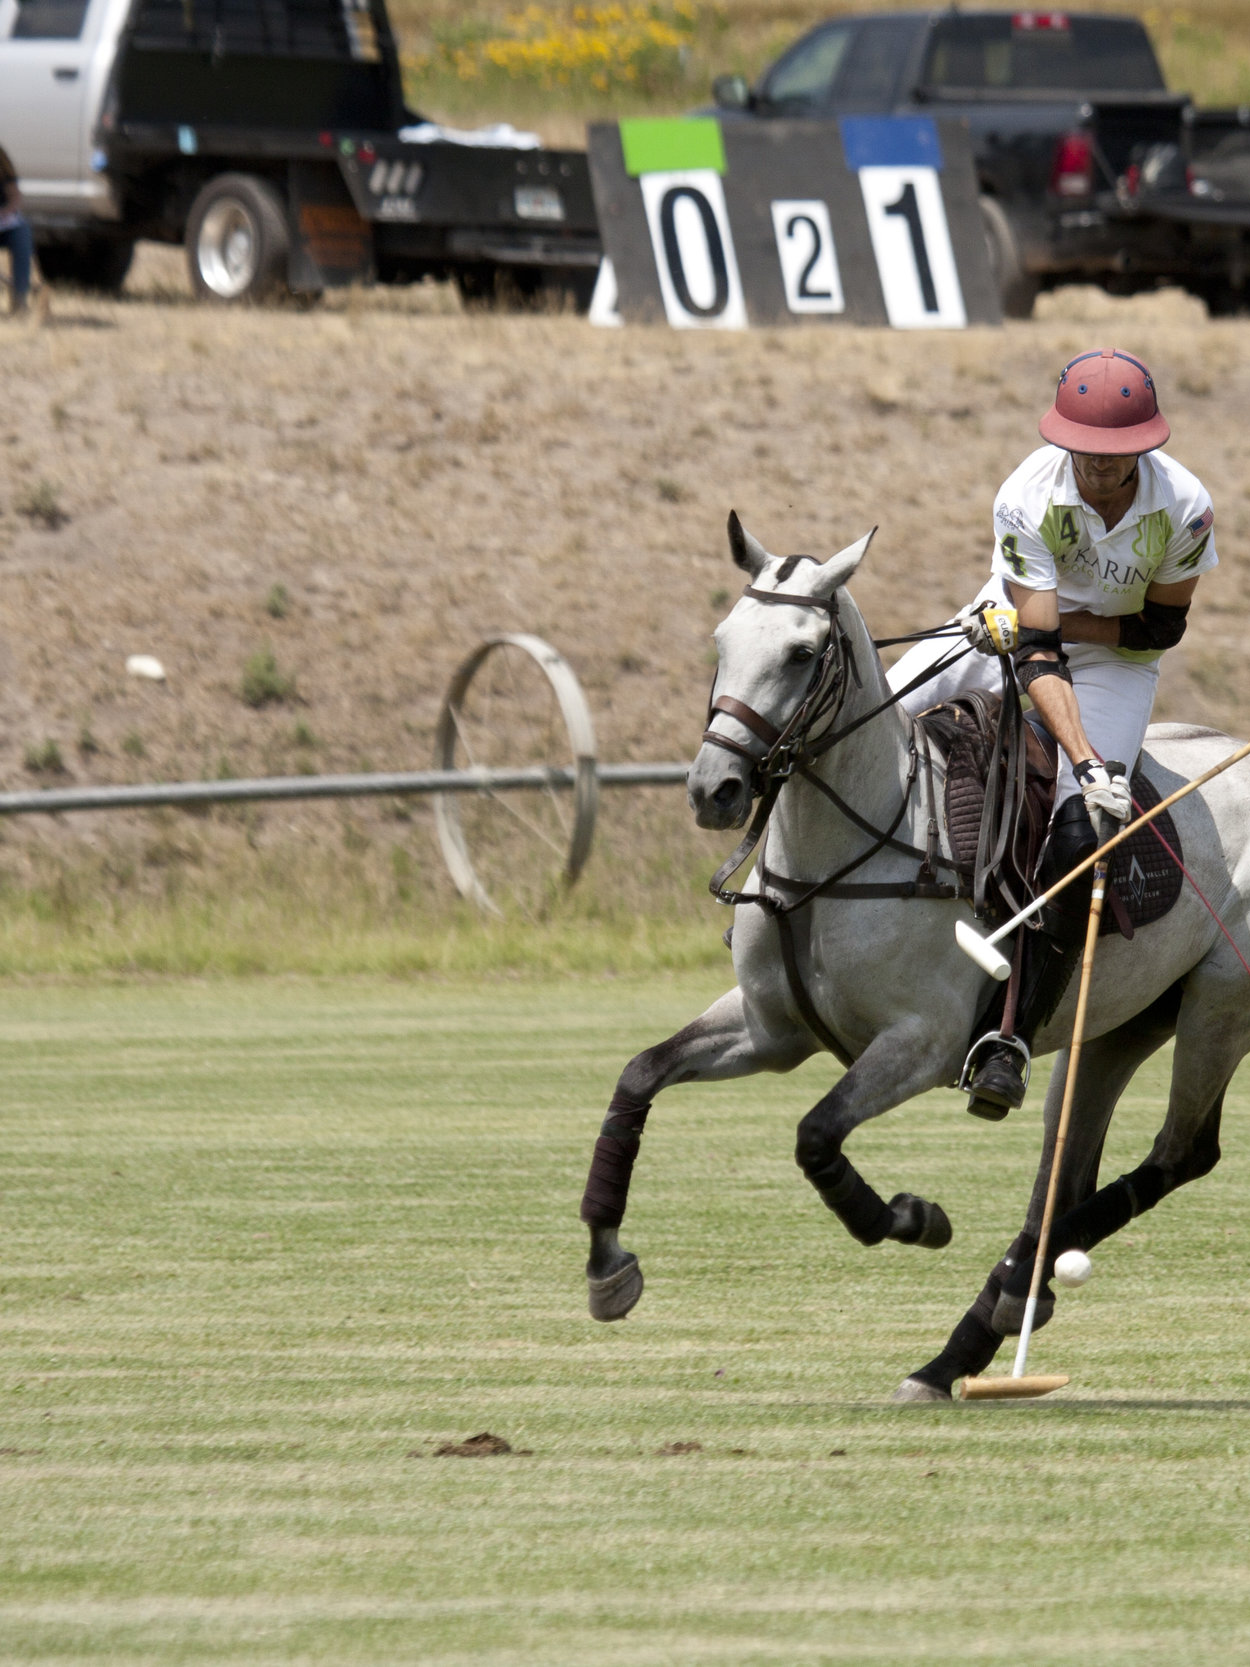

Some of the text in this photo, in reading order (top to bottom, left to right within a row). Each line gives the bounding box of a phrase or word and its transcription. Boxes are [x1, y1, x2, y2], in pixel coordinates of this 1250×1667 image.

[659, 182, 941, 318] 0 2 1
[1060, 511, 1079, 546] 4
[1000, 534, 1027, 577] 4
[1074, 547, 1159, 586] KARIN
[1098, 579, 1131, 595] TEAM
[1145, 869, 1169, 879] VALLEY
